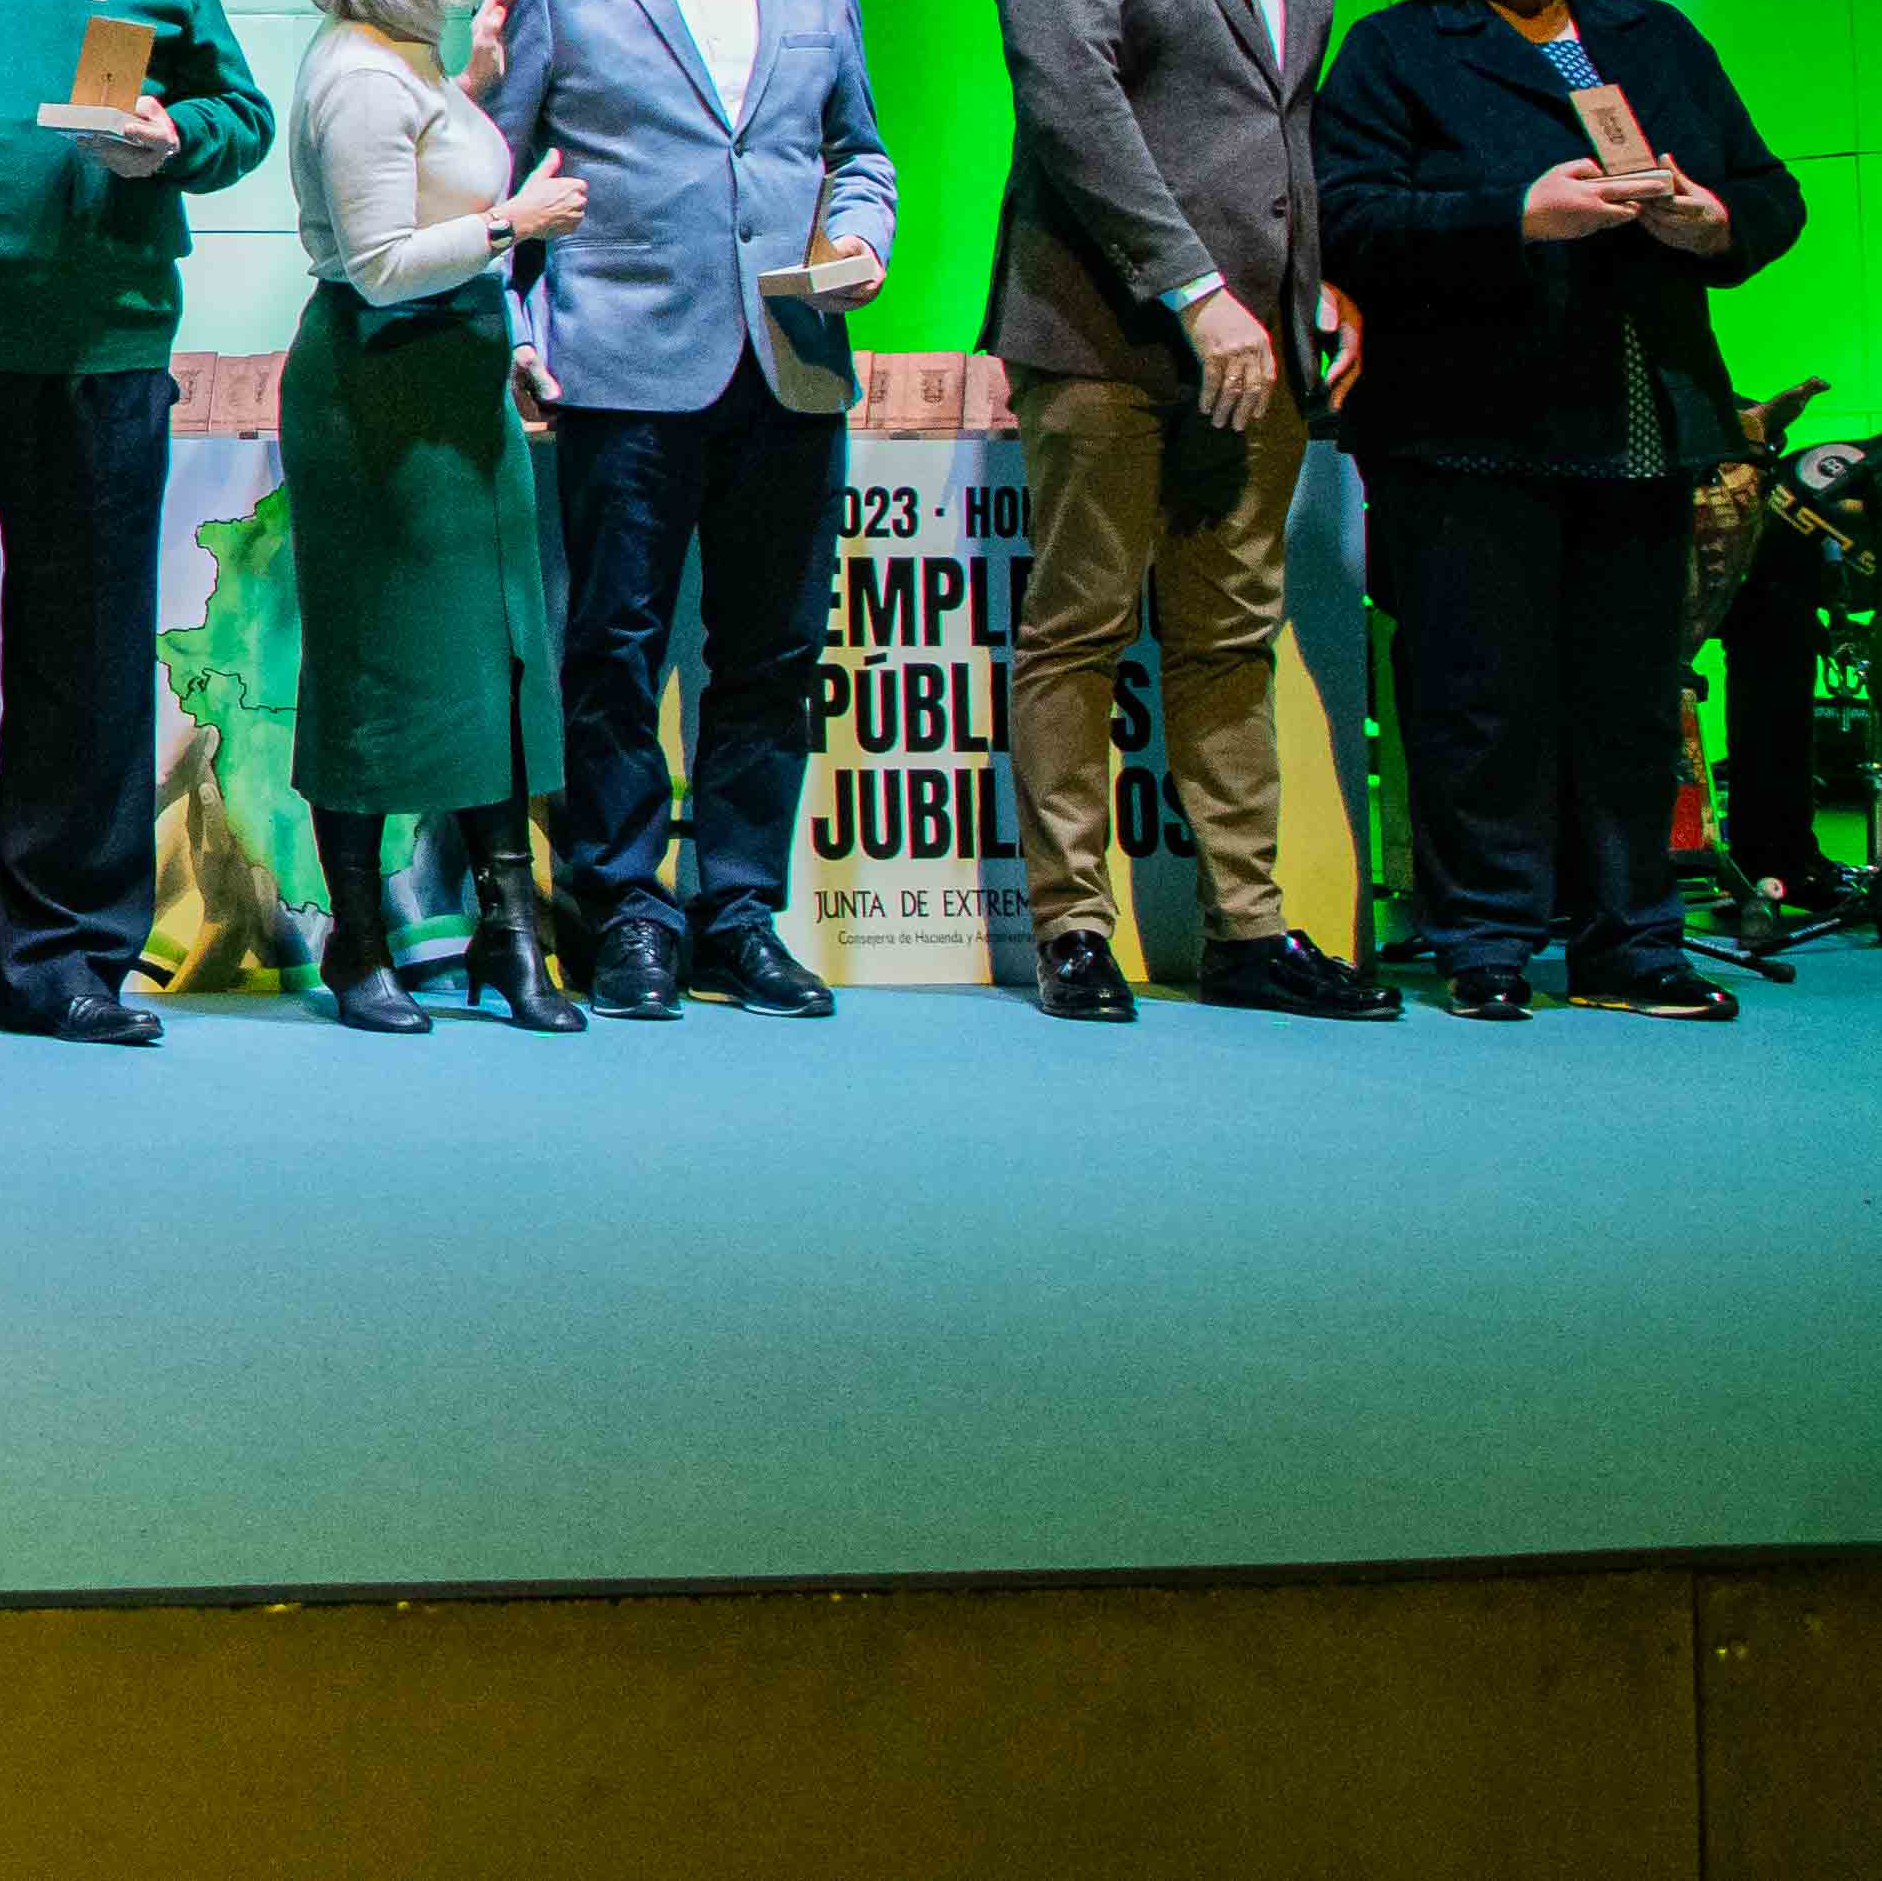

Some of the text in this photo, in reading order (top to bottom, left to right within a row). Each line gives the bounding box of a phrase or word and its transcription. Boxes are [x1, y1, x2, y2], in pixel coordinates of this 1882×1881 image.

[837, 486, 920, 538] 023
[812, 652, 1152, 753] PÚBLIS
[812, 768, 1198, 859] JUBILOS
[814, 889, 886, 923] JUNTA
[901, 890, 928, 918] DE
